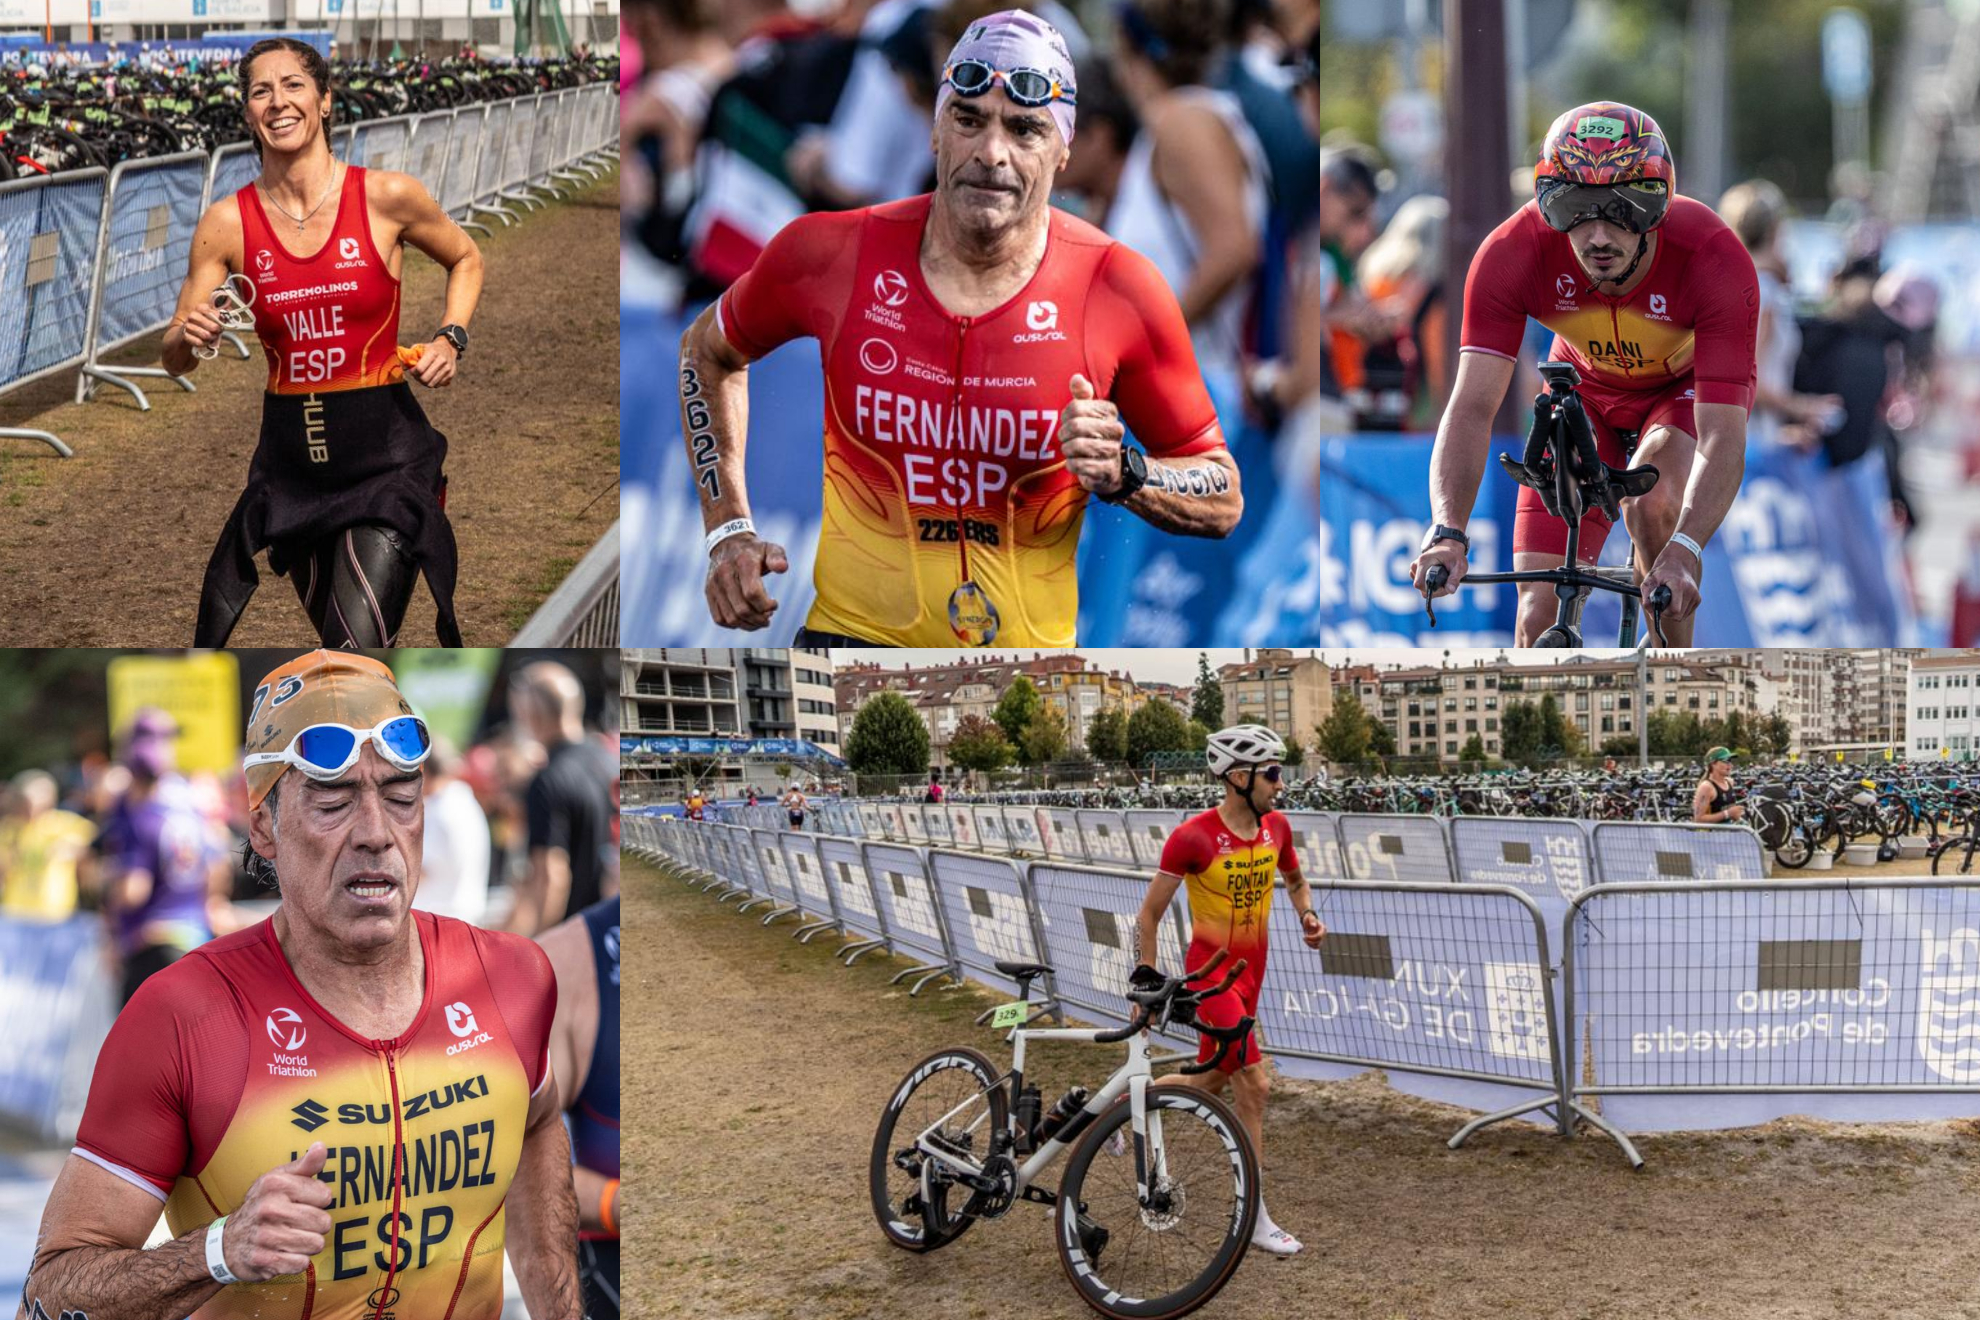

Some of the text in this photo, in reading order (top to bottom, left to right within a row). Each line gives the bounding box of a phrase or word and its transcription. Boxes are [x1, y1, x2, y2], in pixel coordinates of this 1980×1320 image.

[1580, 125, 1614, 136] 3292
[265, 281, 359, 304] TORREMOLINOS
[283, 305, 345, 341] VALLE
[864, 310, 906, 333] Triathlon
[871, 302, 903, 321] World
[1588, 340, 1644, 359] DANI
[290, 347, 346, 383] ESP
[963, 376, 980, 387] DE
[985, 377, 1037, 387] MURCIA
[855, 383, 1058, 460] FERNÁNDEZ
[682, 368, 721, 500] 3621
[904, 452, 1008, 508] ESP
[724, 520, 750, 534] 3621
[918, 518, 1000, 546] 226ERS
[1236, 855, 1273, 869] SUZUKI
[1234, 890, 1262, 909] ESP
[997, 1009, 1020, 1022] 329
[266, 1063, 317, 1077] Triathlon
[273, 1052, 308, 1066] World
[337, 1074, 490, 1124] SUZUKI
[291, 1119, 496, 1211] ERNANDEZ
[333, 1205, 454, 1281] ESP
